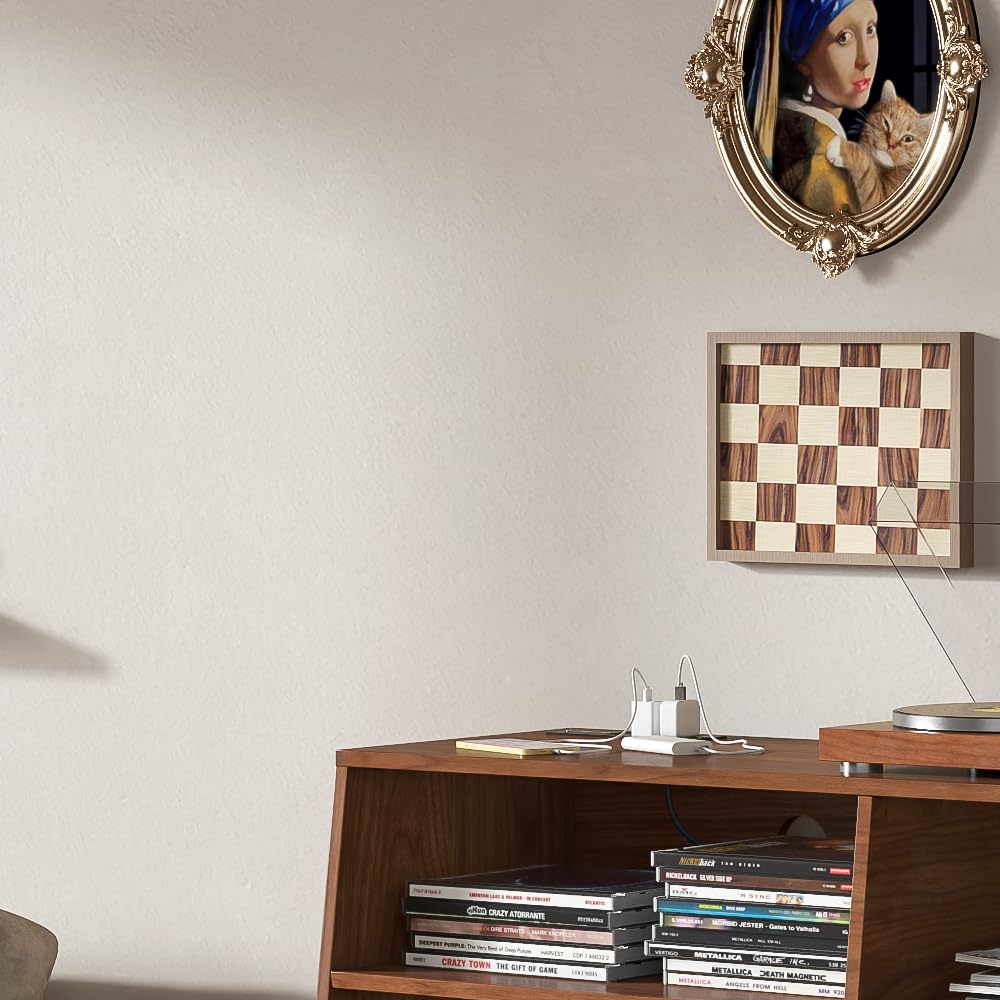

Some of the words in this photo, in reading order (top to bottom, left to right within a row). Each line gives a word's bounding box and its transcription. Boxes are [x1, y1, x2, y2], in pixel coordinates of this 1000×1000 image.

[665, 872, 697, 880] NICKELBACK
[700, 873, 715, 881] SILVER
[488, 908, 508, 917] CRAZY
[509, 910, 546, 920] ATORRANTE
[738, 920, 764, 929] JESTER
[694, 951, 743, 961] METALLICA
[441, 957, 466, 968] CRAZY
[468, 960, 491, 969] TOWN
[496, 962, 509, 970] THE
[511, 964, 526, 972] GIFT
[538, 966, 558, 974] GAME
[711, 966, 753, 976] METALLICA
[760, 969, 785, 978] DEATH
[786, 972, 827, 981] MAGNETIC
[678, 977, 712, 985] METALLICA
